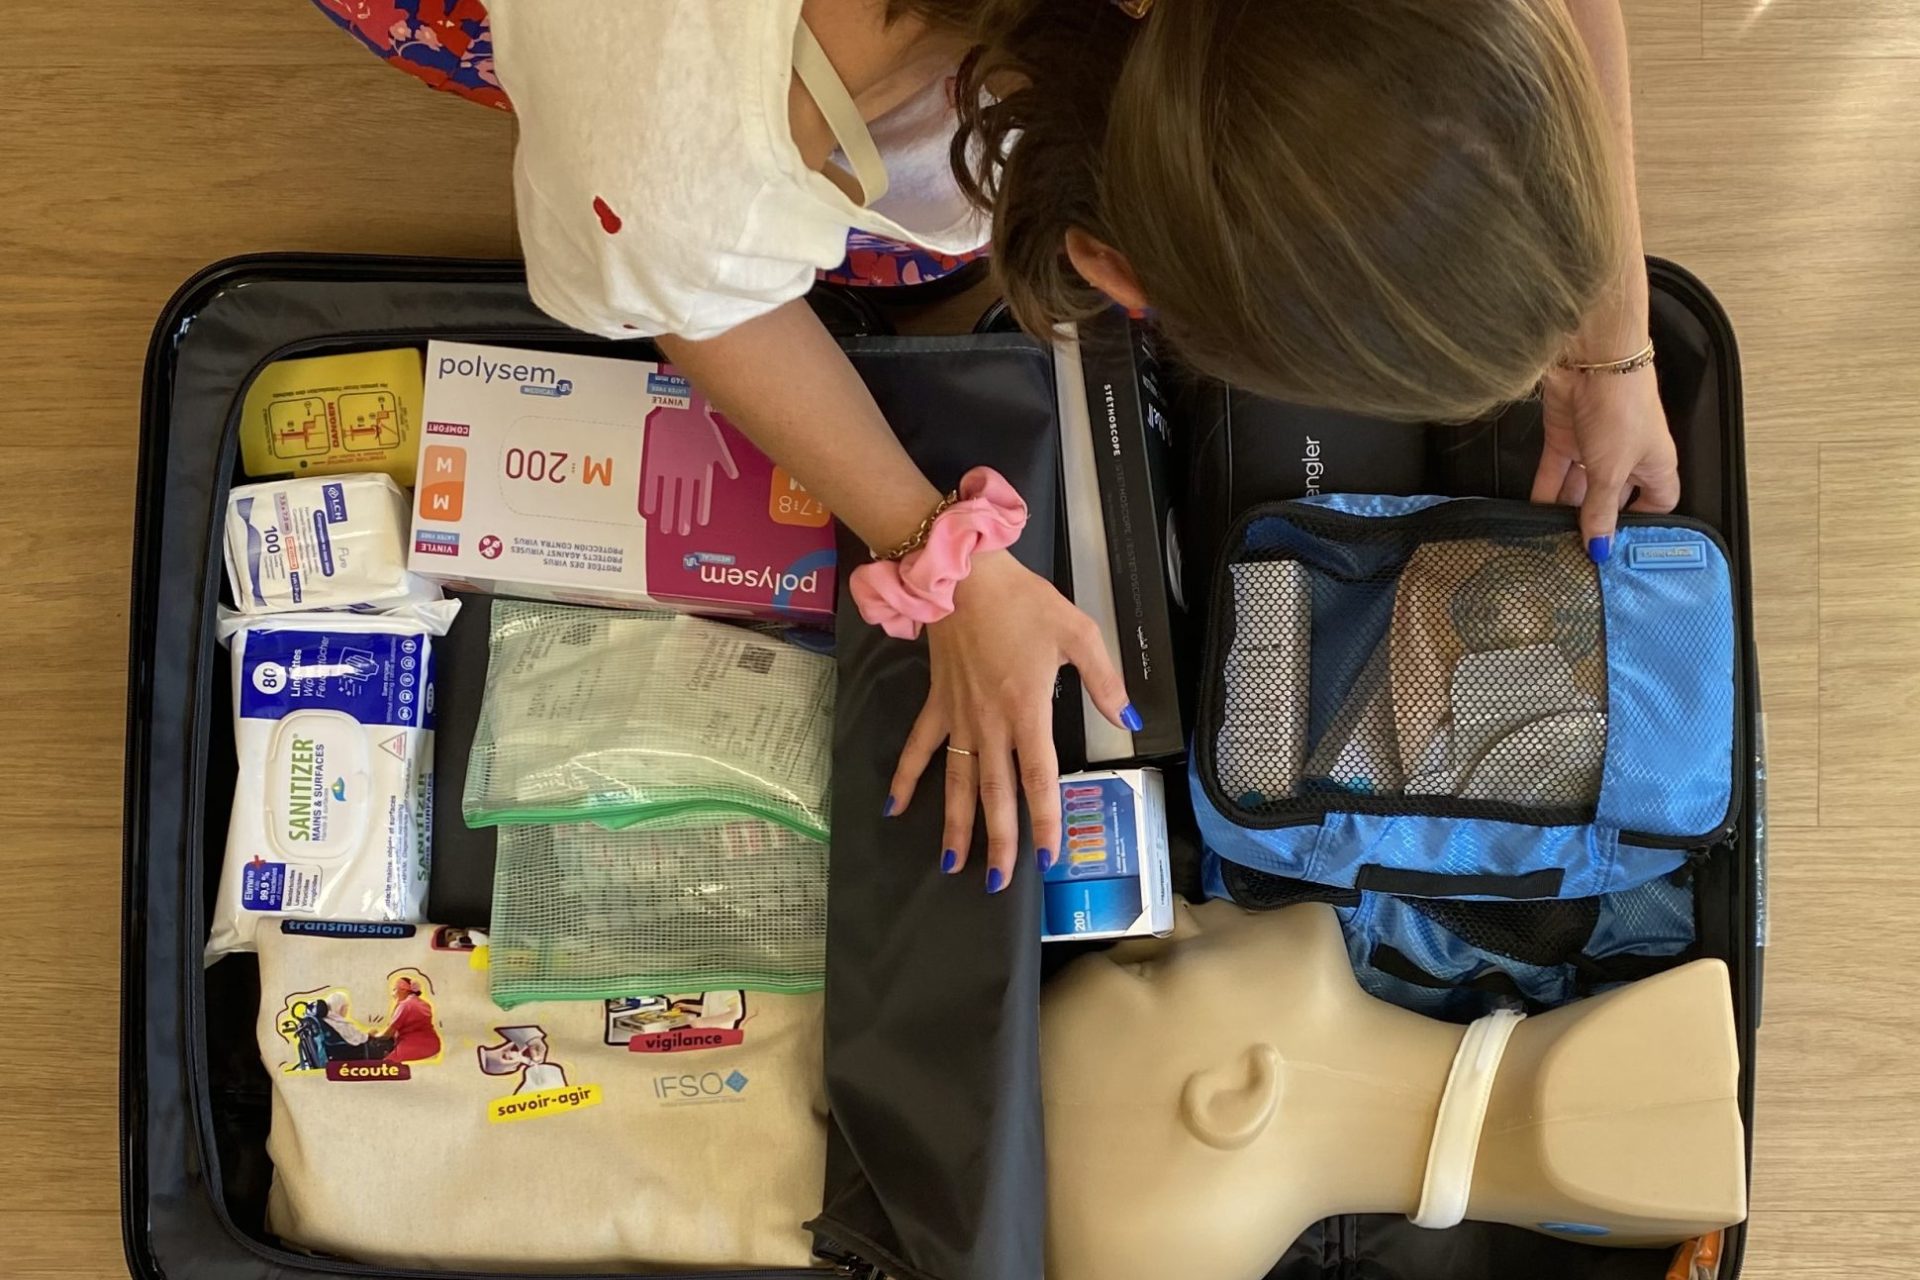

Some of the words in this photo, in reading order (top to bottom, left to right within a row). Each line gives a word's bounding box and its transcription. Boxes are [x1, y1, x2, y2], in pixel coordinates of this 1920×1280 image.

[439, 355, 555, 384] polysem
[652, 397, 684, 407] VINYLE
[327, 402, 340, 448] DANGER
[428, 424, 469, 435] COMFORT
[1104, 384, 1121, 456] STÉTHOSCOPE
[436, 456, 452, 473] M
[505, 447, 568, 484] 200
[583, 455, 612, 487] M
[1302, 435, 1324, 498] engler
[331, 499, 343, 520] LCH
[432, 494, 450, 510] M
[264, 525, 281, 554] 100
[421, 543, 453, 553] VINYLE
[514, 537, 537, 546] VIRUS
[540, 541, 572, 550] CONTRA
[510, 546, 545, 556] VIRUSES
[547, 550, 580, 560] AGAINST
[583, 553, 623, 564] PROTECTS
[543, 558, 567, 567] VIRUS
[701, 565, 818, 596] polysem
[314, 744, 325, 799] SURFACES
[289, 739, 314, 842] SANITIZER
[314, 800, 322, 808] &
[312, 810, 321, 842] MAINS
[417, 773, 425, 882] SANITIZER
[261, 871, 270, 881] %
[260, 882, 271, 901] 99,9
[287, 920, 404, 935] transmission
[1074, 911, 1085, 932] 200
[645, 1031, 723, 1052] vigilance
[339, 1061, 399, 1078] écoute
[653, 1072, 723, 1098] IFSO
[497, 1087, 592, 1117] savoir-agir
